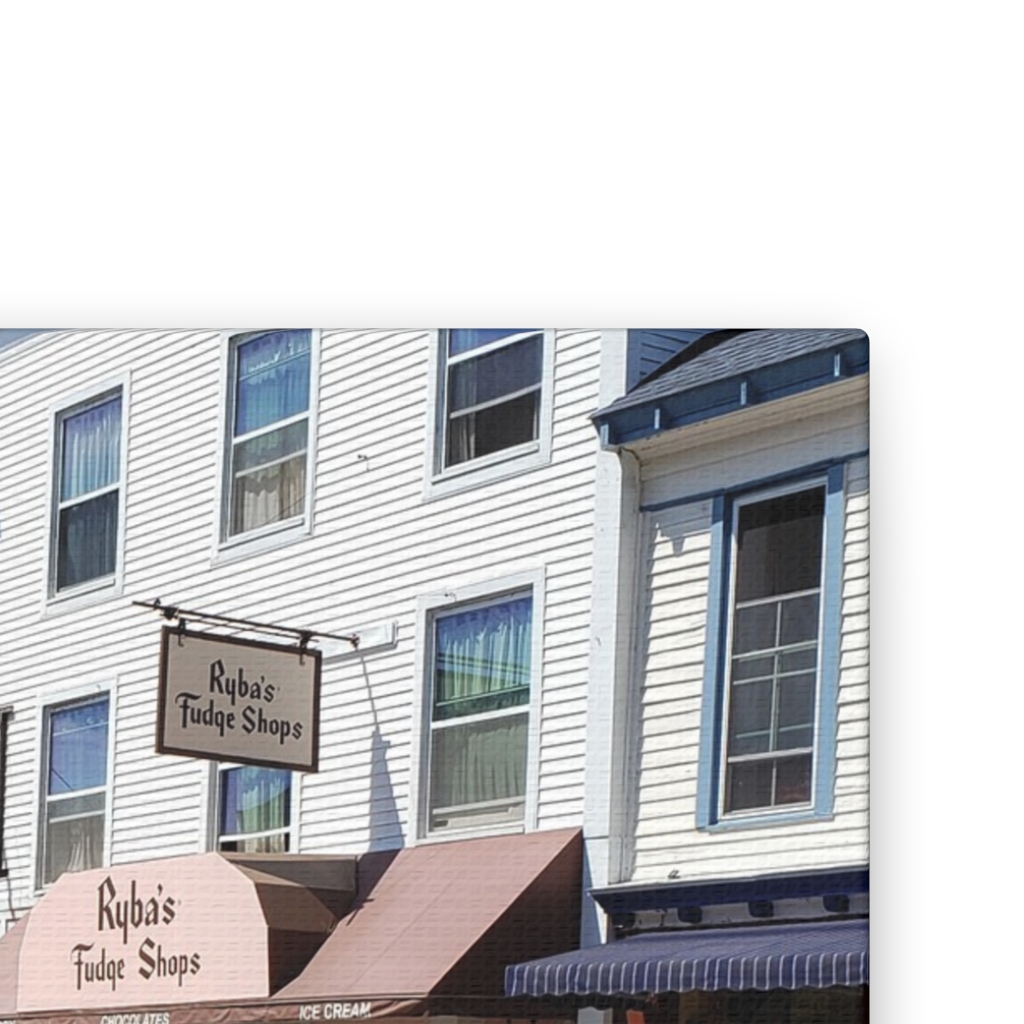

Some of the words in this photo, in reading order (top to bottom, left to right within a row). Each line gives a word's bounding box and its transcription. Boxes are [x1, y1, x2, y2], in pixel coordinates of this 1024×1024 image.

[209, 658, 276, 706] Ryba's
[174, 691, 236, 737] Fudge
[241, 705, 304, 745] Shops
[97, 875, 176, 945] Ryba's
[70, 941, 126, 992] Fudge
[138, 937, 201, 987] Shops
[299, 1004, 321, 1020] ICE
[323, 1001, 372, 1019] CREAM
